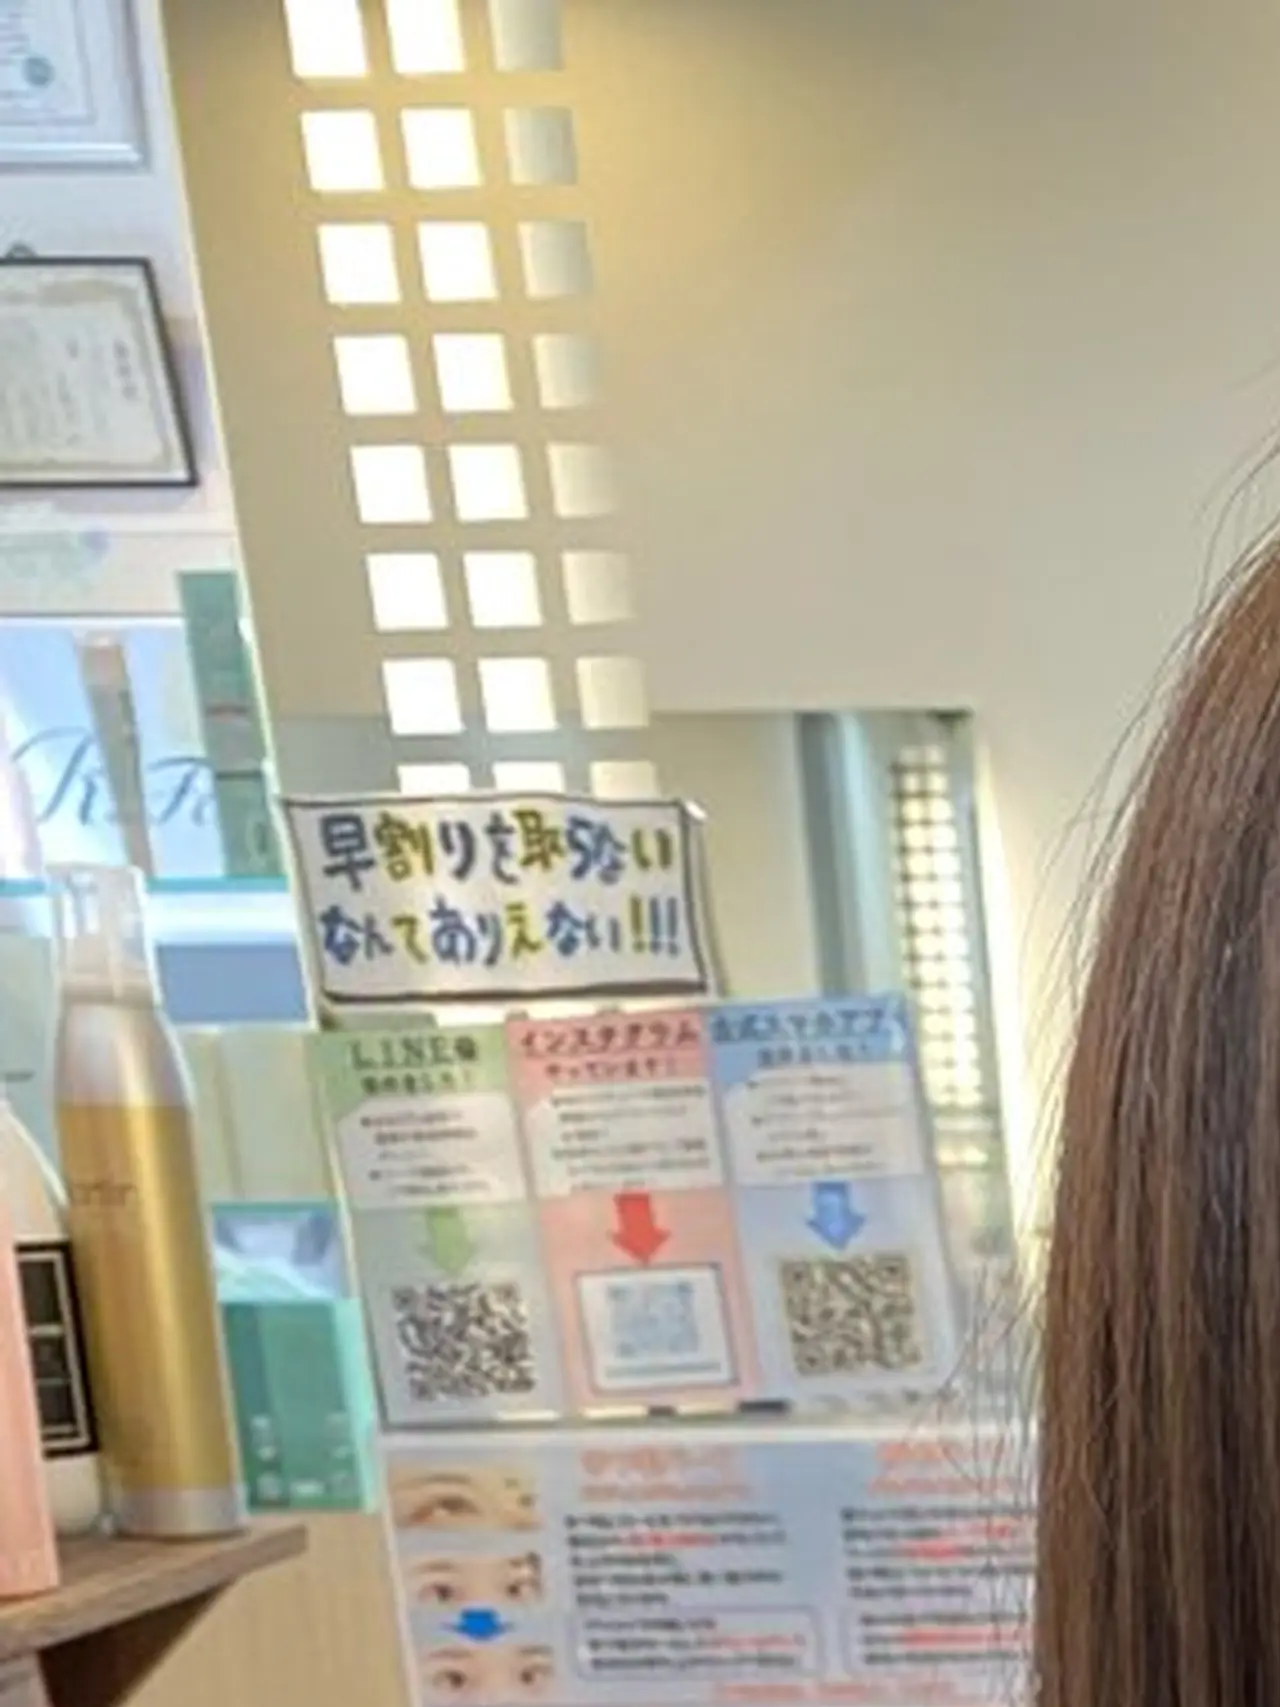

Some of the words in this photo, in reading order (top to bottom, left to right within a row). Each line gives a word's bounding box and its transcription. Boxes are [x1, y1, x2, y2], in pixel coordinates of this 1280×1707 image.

[319, 808, 676, 891] 早割りを取らない
